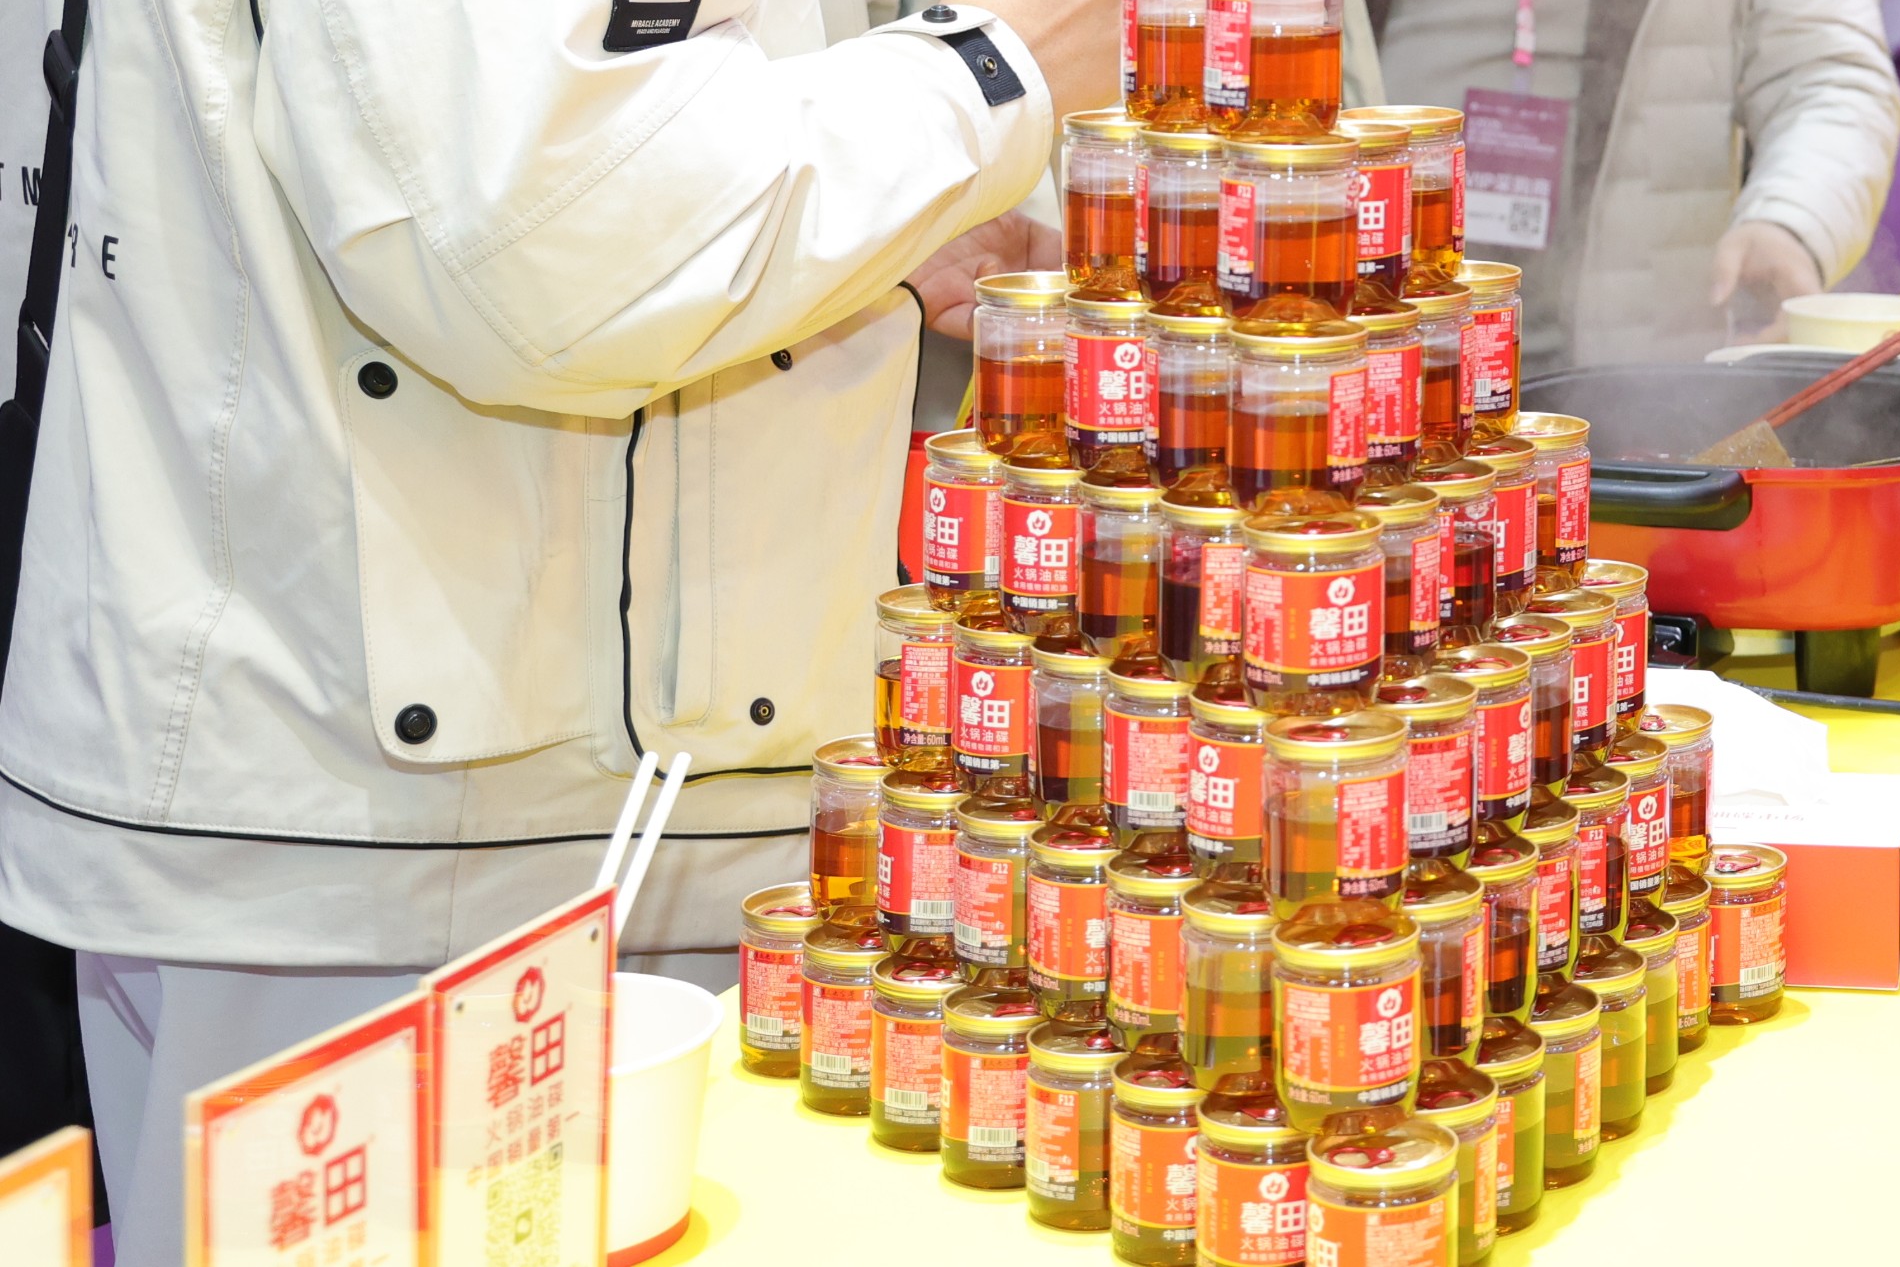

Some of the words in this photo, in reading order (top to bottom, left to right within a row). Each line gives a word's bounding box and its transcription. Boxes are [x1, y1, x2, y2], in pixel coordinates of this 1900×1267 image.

[1232, 0, 1249, 13] F12
[631, 19, 656, 28] MIRACLE
[655, 18, 681, 27] ACADEMY
[1237, 185, 1252, 199] F12
[1358, 200, 1385, 230] 田
[1501, 311, 1513, 322] F12
[1098, 402, 1144, 416] 火锅油
[1013, 535, 1069, 567] 馨田
[1013, 568, 1068, 582] 火锅油碟
[1309, 603, 1369, 640] 馨田
[1310, 636, 1368, 656] 火锅油碟
[1617, 645, 1635, 674] 田
[961, 694, 1010, 729] 馨田
[961, 726, 1009, 743] 火锅油碟
[1189, 768, 1235, 809] 馨田
[1589, 829, 1604, 841] F12
[992, 862, 1009, 874] F12
[1555, 860, 1568, 873] F12
[1630, 874, 1665, 892] 国销量第一
[1359, 1012, 1414, 1056] 馨田
[486, 1010, 565, 1110] 馨田
[1058, 1094, 1075, 1106] F12
[1165, 1163, 1197, 1195] 馨
[1166, 1197, 1197, 1211] 火锅
[1240, 1199, 1306, 1234] 馨田
[1240, 1234, 1306, 1251] 火锅油碟
